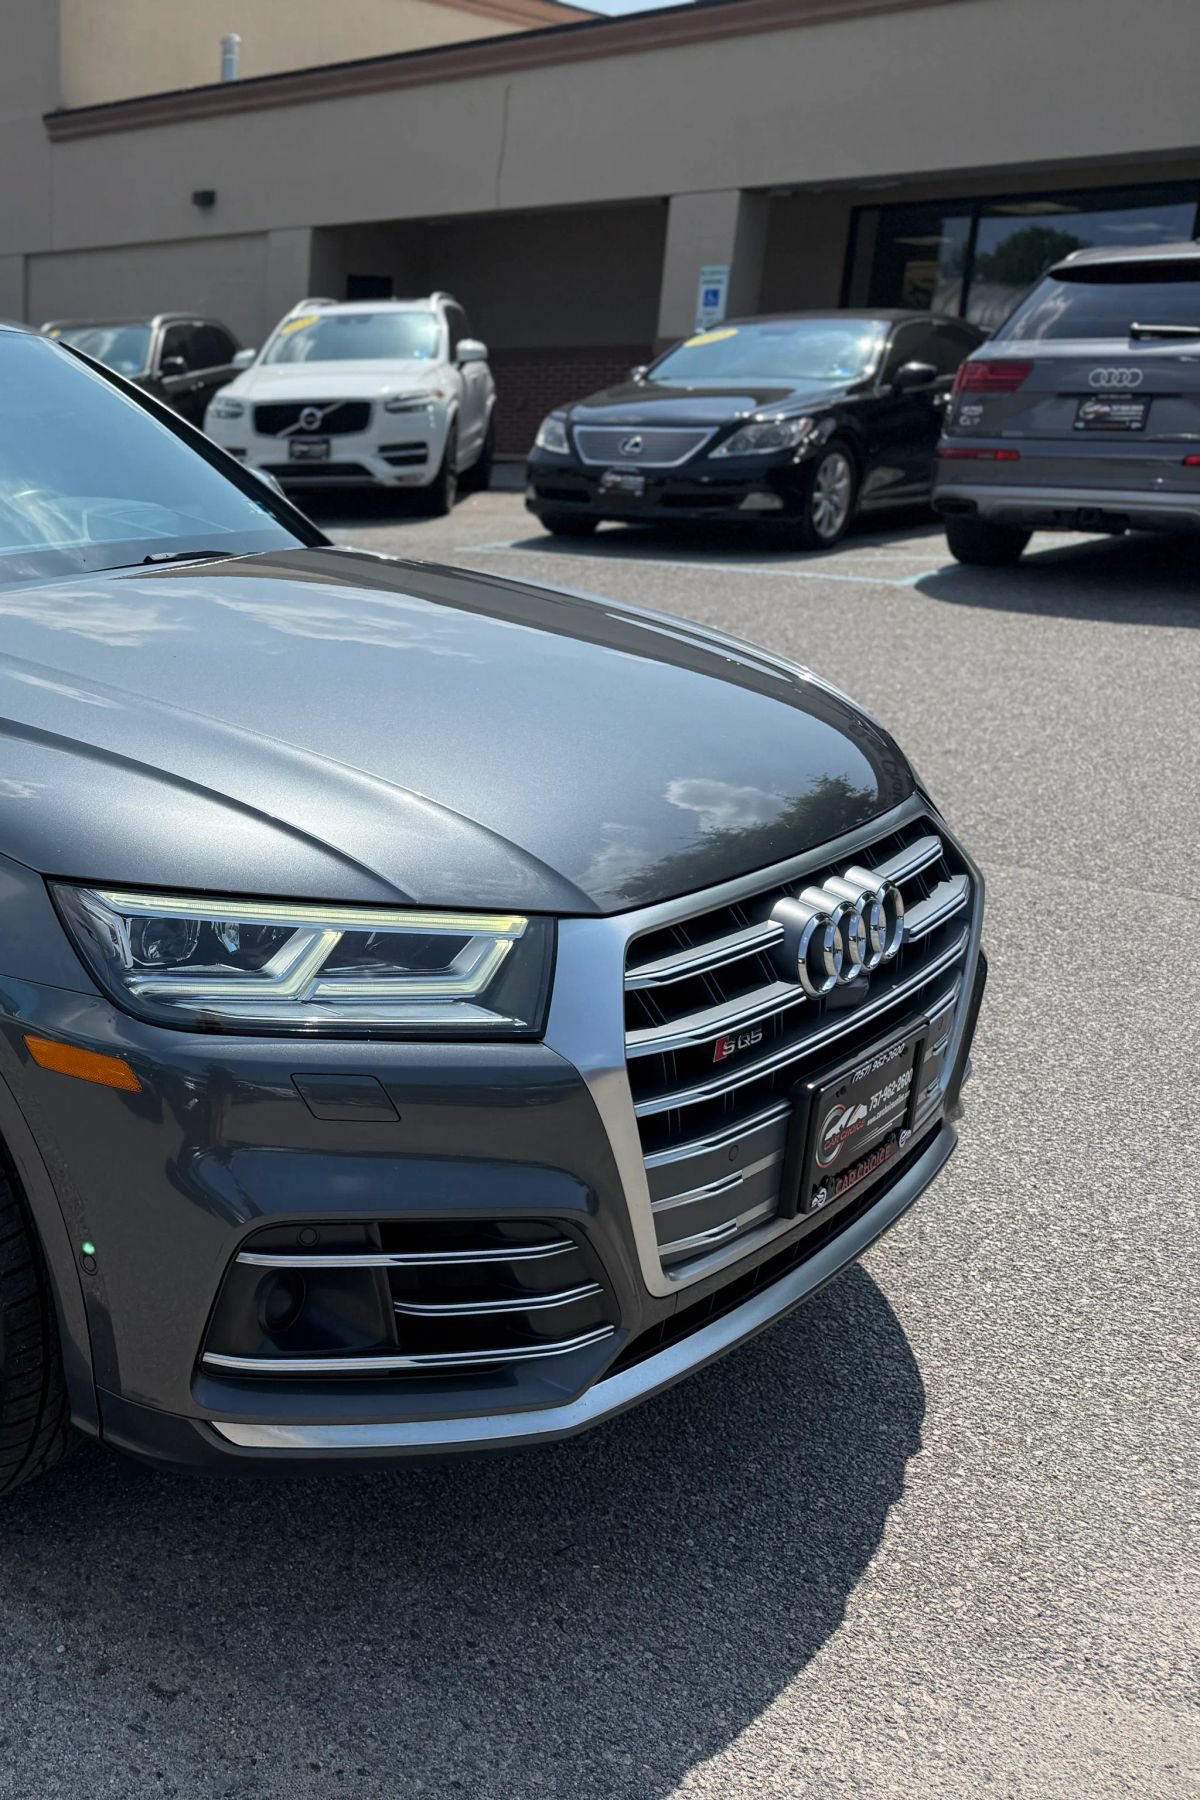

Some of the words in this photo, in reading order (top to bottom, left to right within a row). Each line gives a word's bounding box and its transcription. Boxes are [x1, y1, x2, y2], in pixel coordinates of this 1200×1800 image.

[722, 1028, 763, 1056] SQ5
[869, 1067, 913, 1111] 757-962-2600
[836, 1169, 856, 1194] CAR
[857, 1144, 891, 1179] CHOICE
